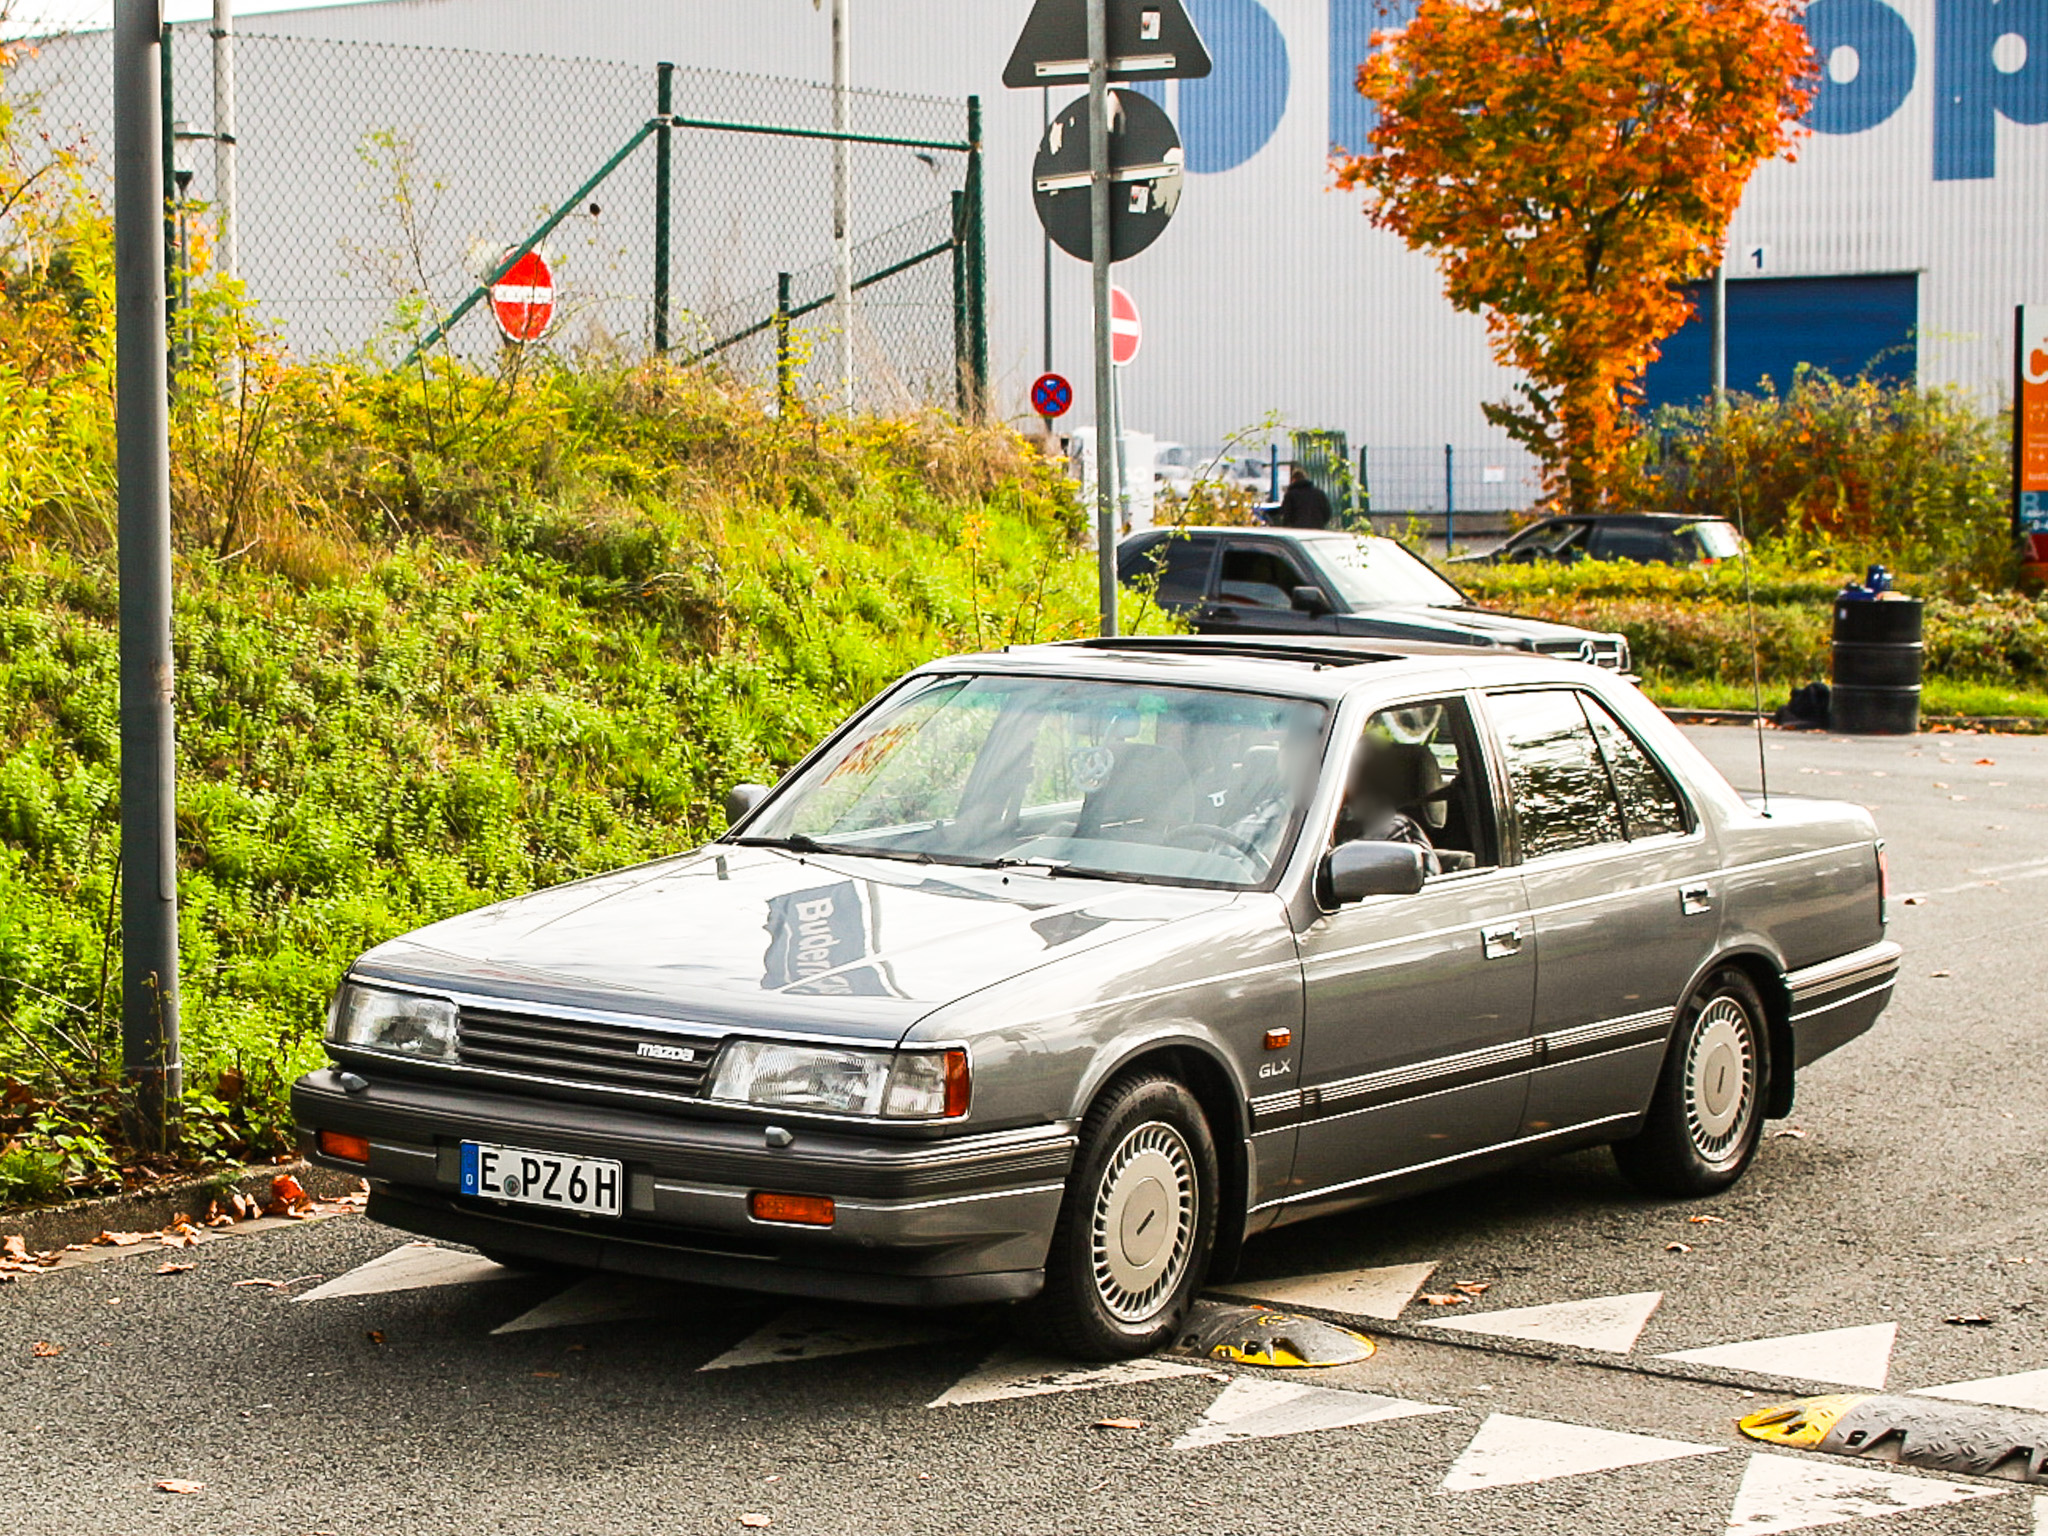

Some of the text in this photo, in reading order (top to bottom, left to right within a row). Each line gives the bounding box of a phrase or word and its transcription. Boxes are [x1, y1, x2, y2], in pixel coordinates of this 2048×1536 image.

[1751, 247, 1763, 269] 1
[636, 1042, 695, 1062] mazda
[1258, 1058, 1292, 1079] GLX
[481, 1152, 500, 1192] E
